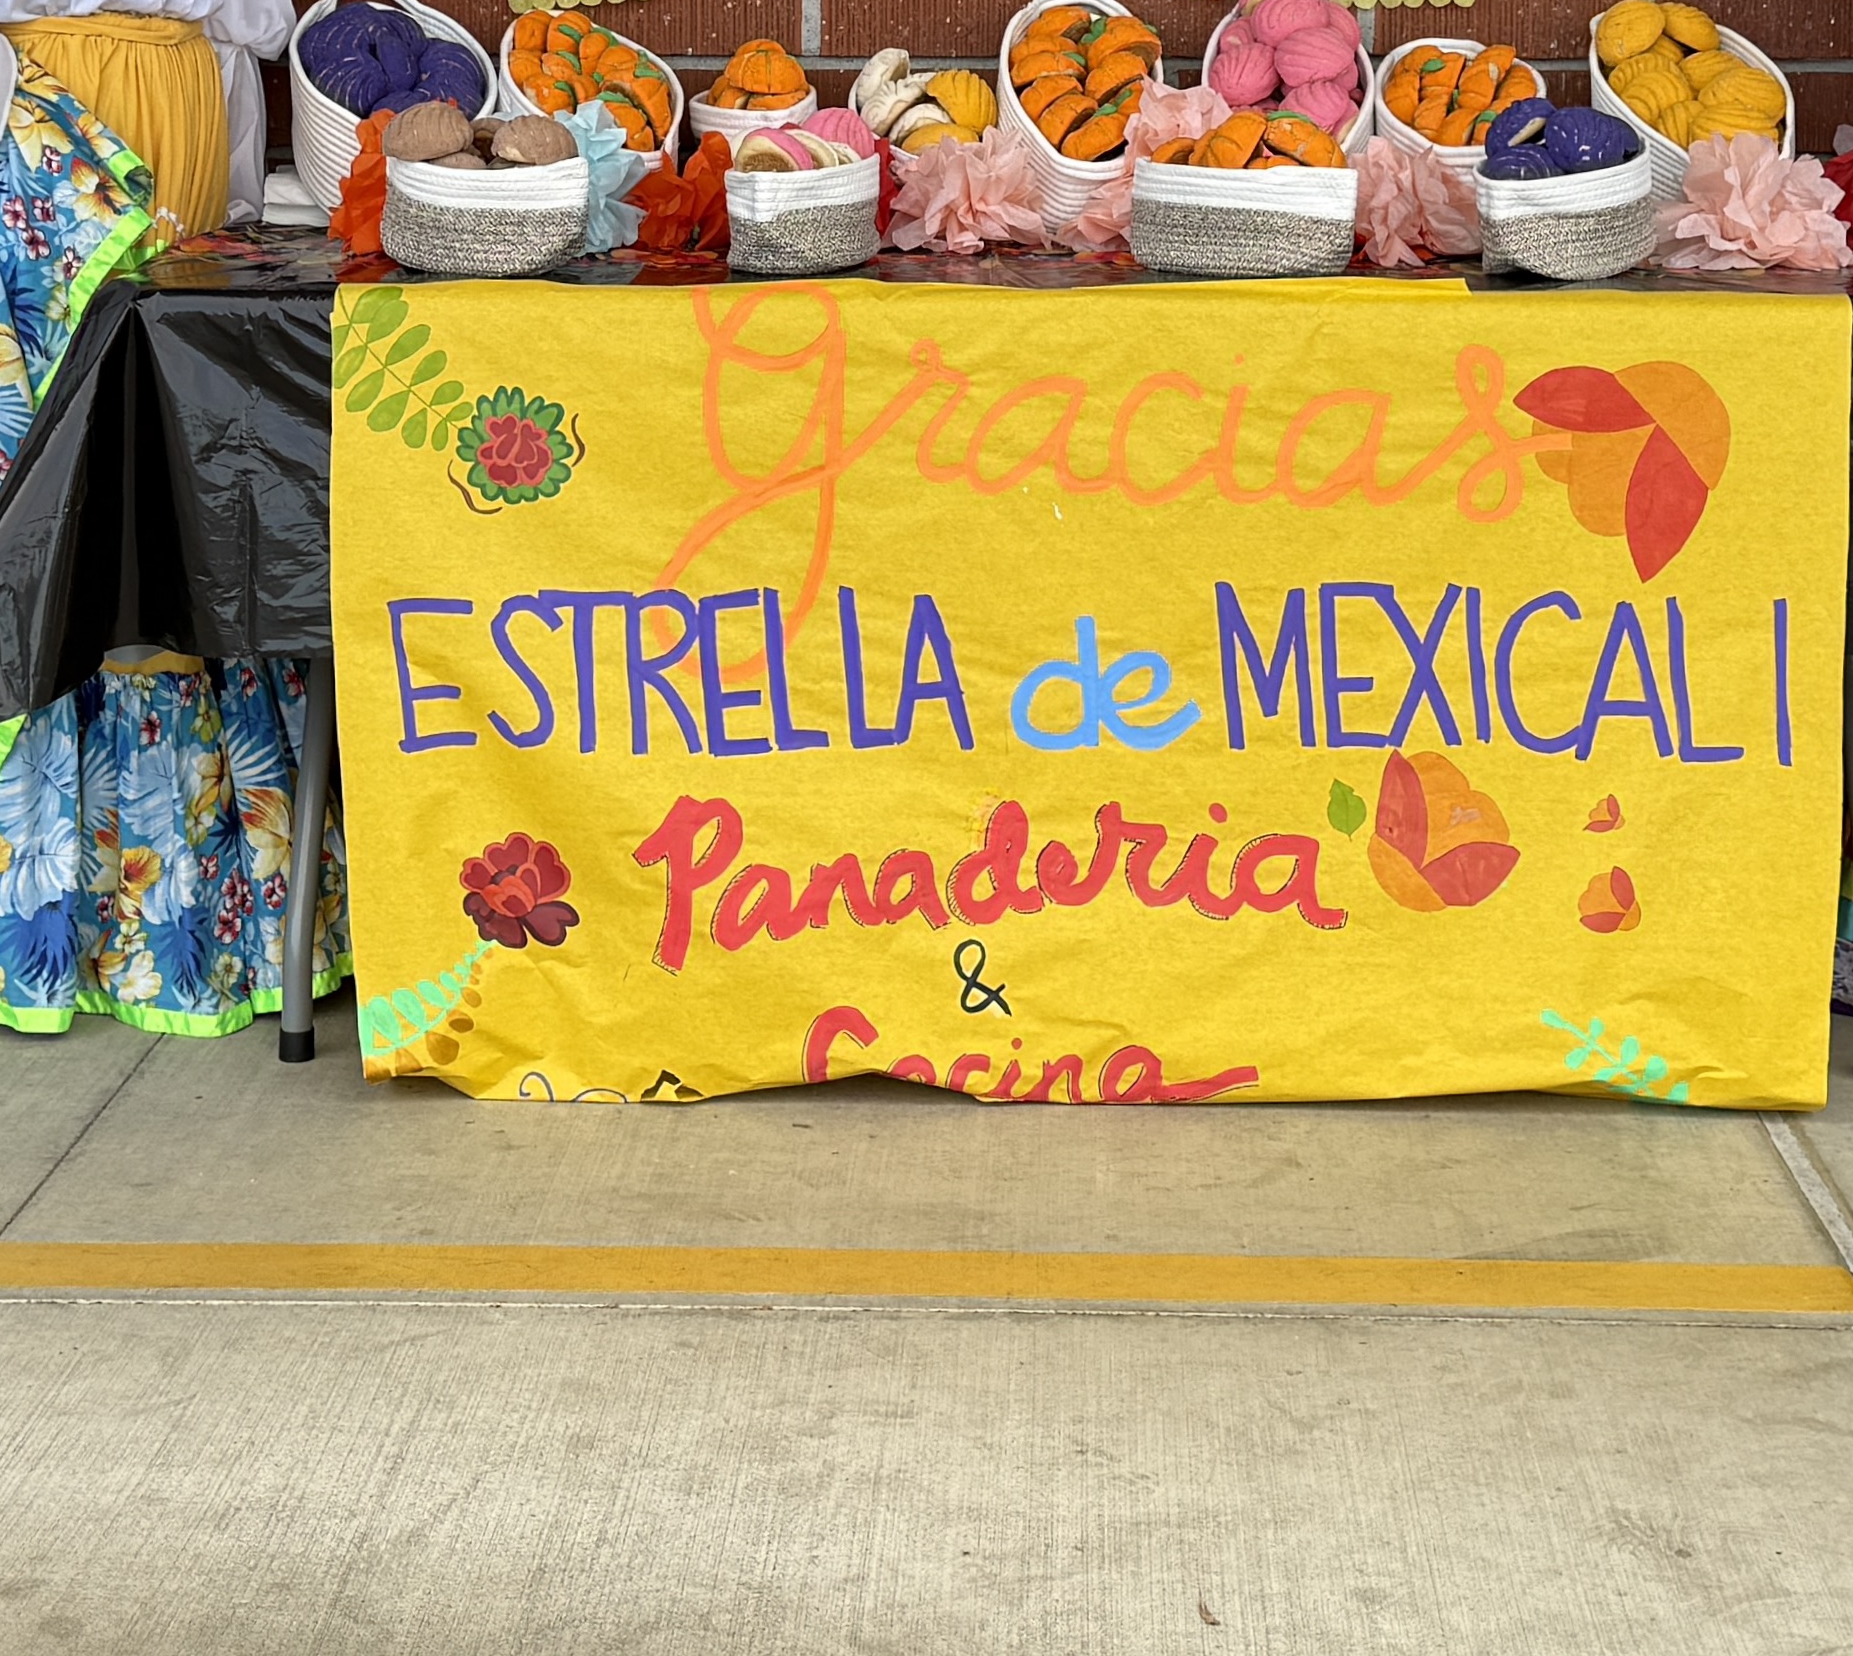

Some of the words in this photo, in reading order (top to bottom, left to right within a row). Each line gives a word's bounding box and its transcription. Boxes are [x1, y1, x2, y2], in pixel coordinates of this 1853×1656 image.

[387, 586, 974, 756] ESTRELLA
[1010, 614, 1202, 751] de
[632, 796, 1348, 976] Panaderia
[953, 938, 1012, 1017] &
